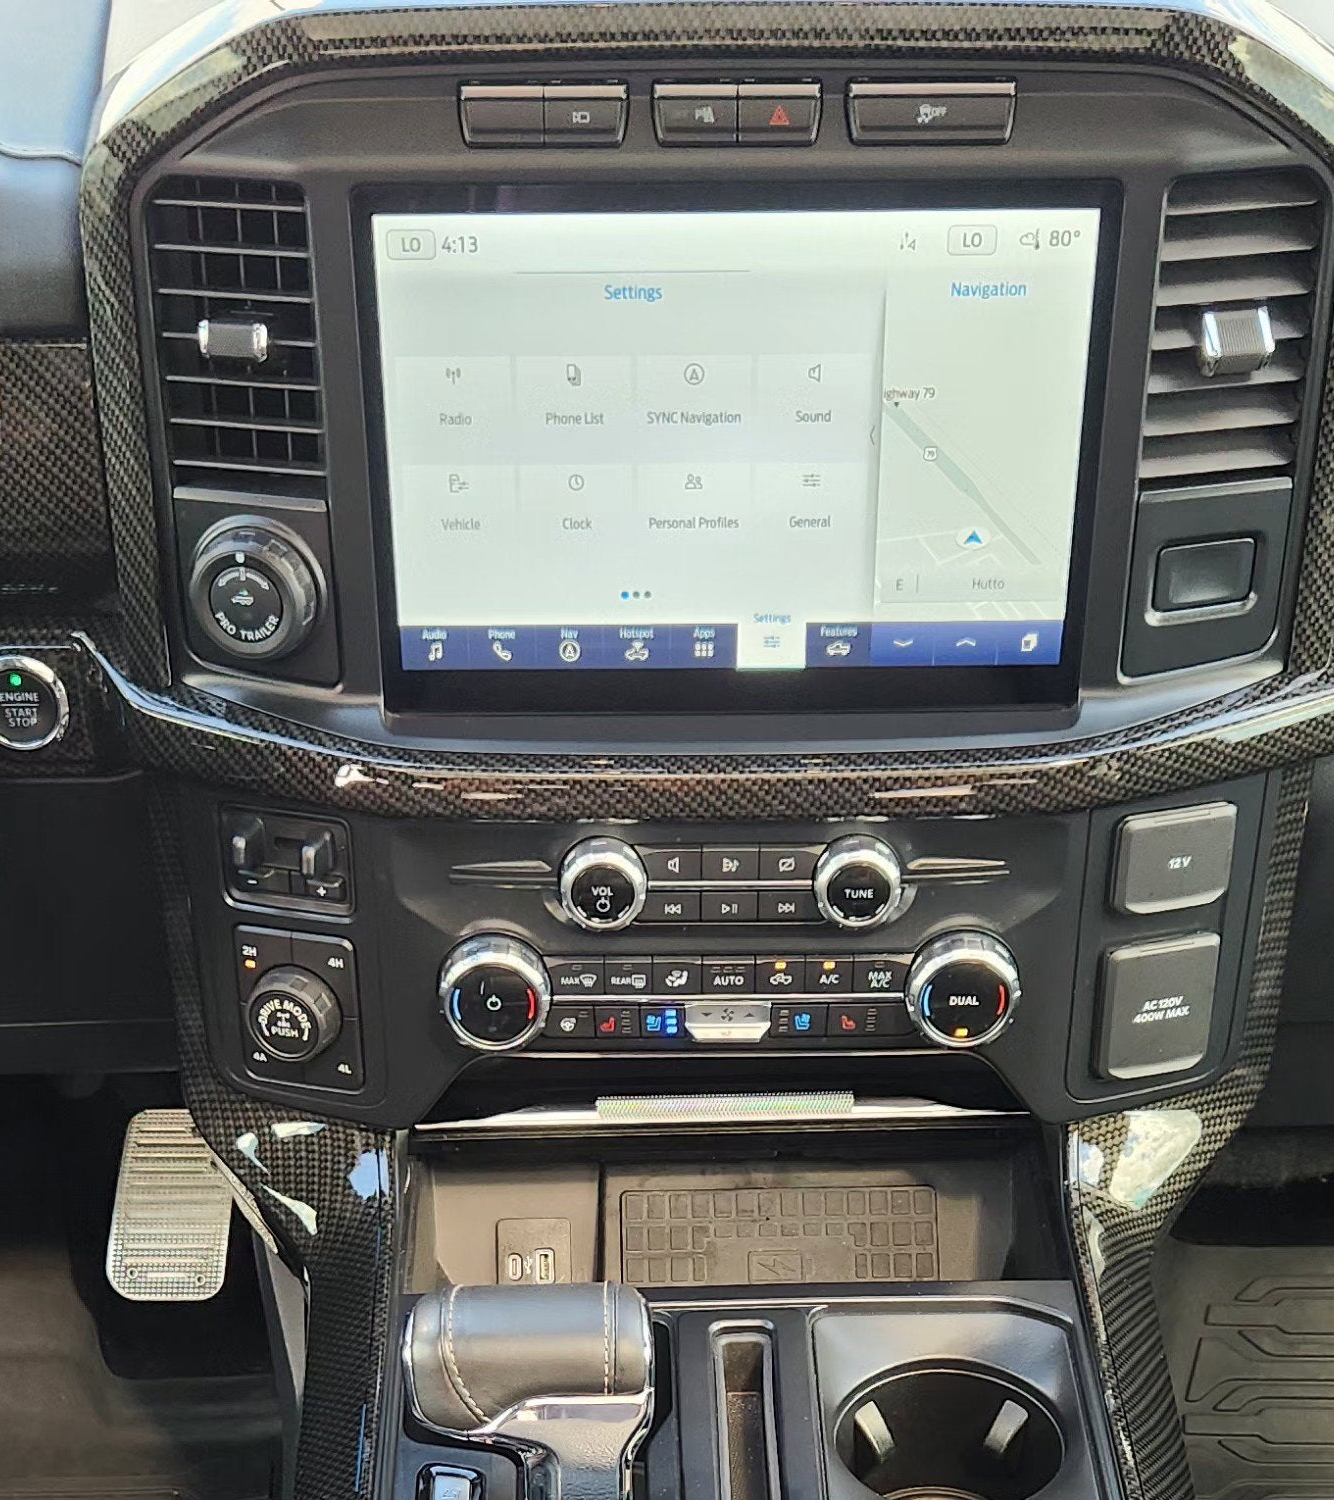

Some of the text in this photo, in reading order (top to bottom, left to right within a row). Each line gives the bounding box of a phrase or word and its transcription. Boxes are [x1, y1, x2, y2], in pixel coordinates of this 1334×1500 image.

[401, 235, 479, 254] LO 4:13
[962, 232, 983, 248] LO
[603, 283, 663, 302] Settings
[950, 281, 1027, 300] Navigation
[883, 387, 935, 403] ighway 79
[439, 412, 472, 426] Radio
[545, 412, 605, 426] Phone List
[646, 410, 742, 427] SYNC Navigation
[795, 410, 832, 424] Sound
[441, 518, 481, 532] Vehicle
[562, 517, 593, 531] Clock
[648, 516, 740, 530] Personal Profiles
[788, 515, 831, 530] General
[896, 579, 903, 591] E
[972, 578, 1005, 590] Hutto
[753, 612, 792, 626] Settings
[215, 611, 280, 642] PRO TRAILER
[422, 627, 448, 640] Audio
[488, 627, 516, 640] Phone
[560, 627, 579, 640] Nav
[820, 625, 859, 638] Features
[619, 627, 655, 641] Hotspot
[693, 627, 715, 641] Apps
[5, 707, 38, 719] START
[8, 718, 38, 728] STOP
[591, 886, 613, 897] VOL
[844, 888, 874, 899] TUNE
[241, 944, 258, 958] 2H
[327, 956, 344, 970] 4H
[560, 975, 580, 986] MAX
[610, 975, 632, 986] REAR
[713, 975, 744, 986] AUTO
[819, 973, 840, 985] A/C
[867, 970, 892, 981] MAX
[869, 979, 891, 989] A/C
[948, 995, 980, 1006] DUAL
[1142, 996, 1184, 1012] AC 120V
[257, 999, 312, 1030] DRIVE MODE
[1132, 1005, 1190, 1024] 400W MAX
[270, 1026, 299, 1039] PUSH
[252, 1051, 268, 1063] 4A
[337, 1062, 353, 1075] 4L
